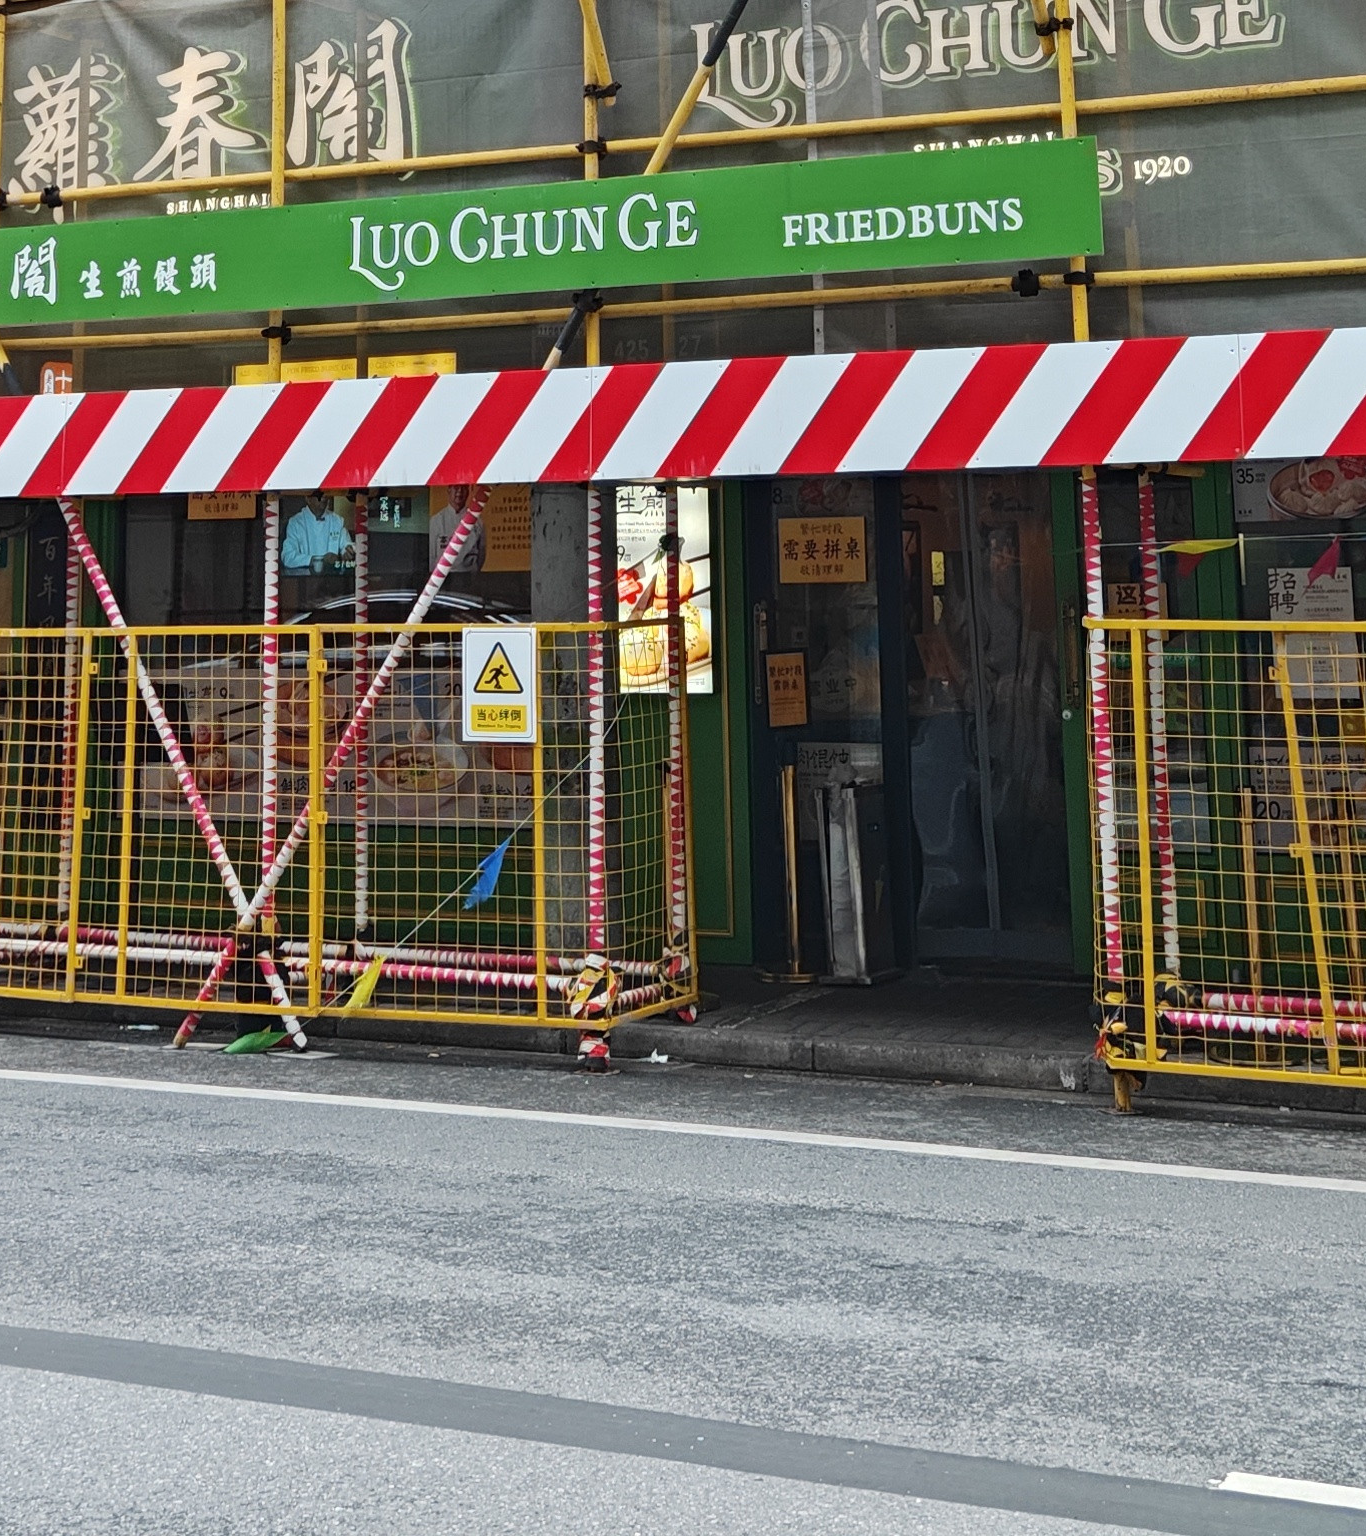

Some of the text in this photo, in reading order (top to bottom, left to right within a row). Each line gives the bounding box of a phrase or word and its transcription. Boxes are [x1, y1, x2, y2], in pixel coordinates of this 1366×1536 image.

[690, 20, 842, 129] LUO
[1133, 155, 1192, 185] 1920
[166, 193, 271, 215] SHANGHAI
[782, 198, 1024, 247] FRIEDBUNS
[349, 193, 700, 291] LUO CHUN GE
[1236, 467, 1254, 484] 35
[783, 537, 861, 561] 需要拼桌
[1268, 568, 1299, 615] 招聘
[476, 708, 522, 721] 当心绊倒
